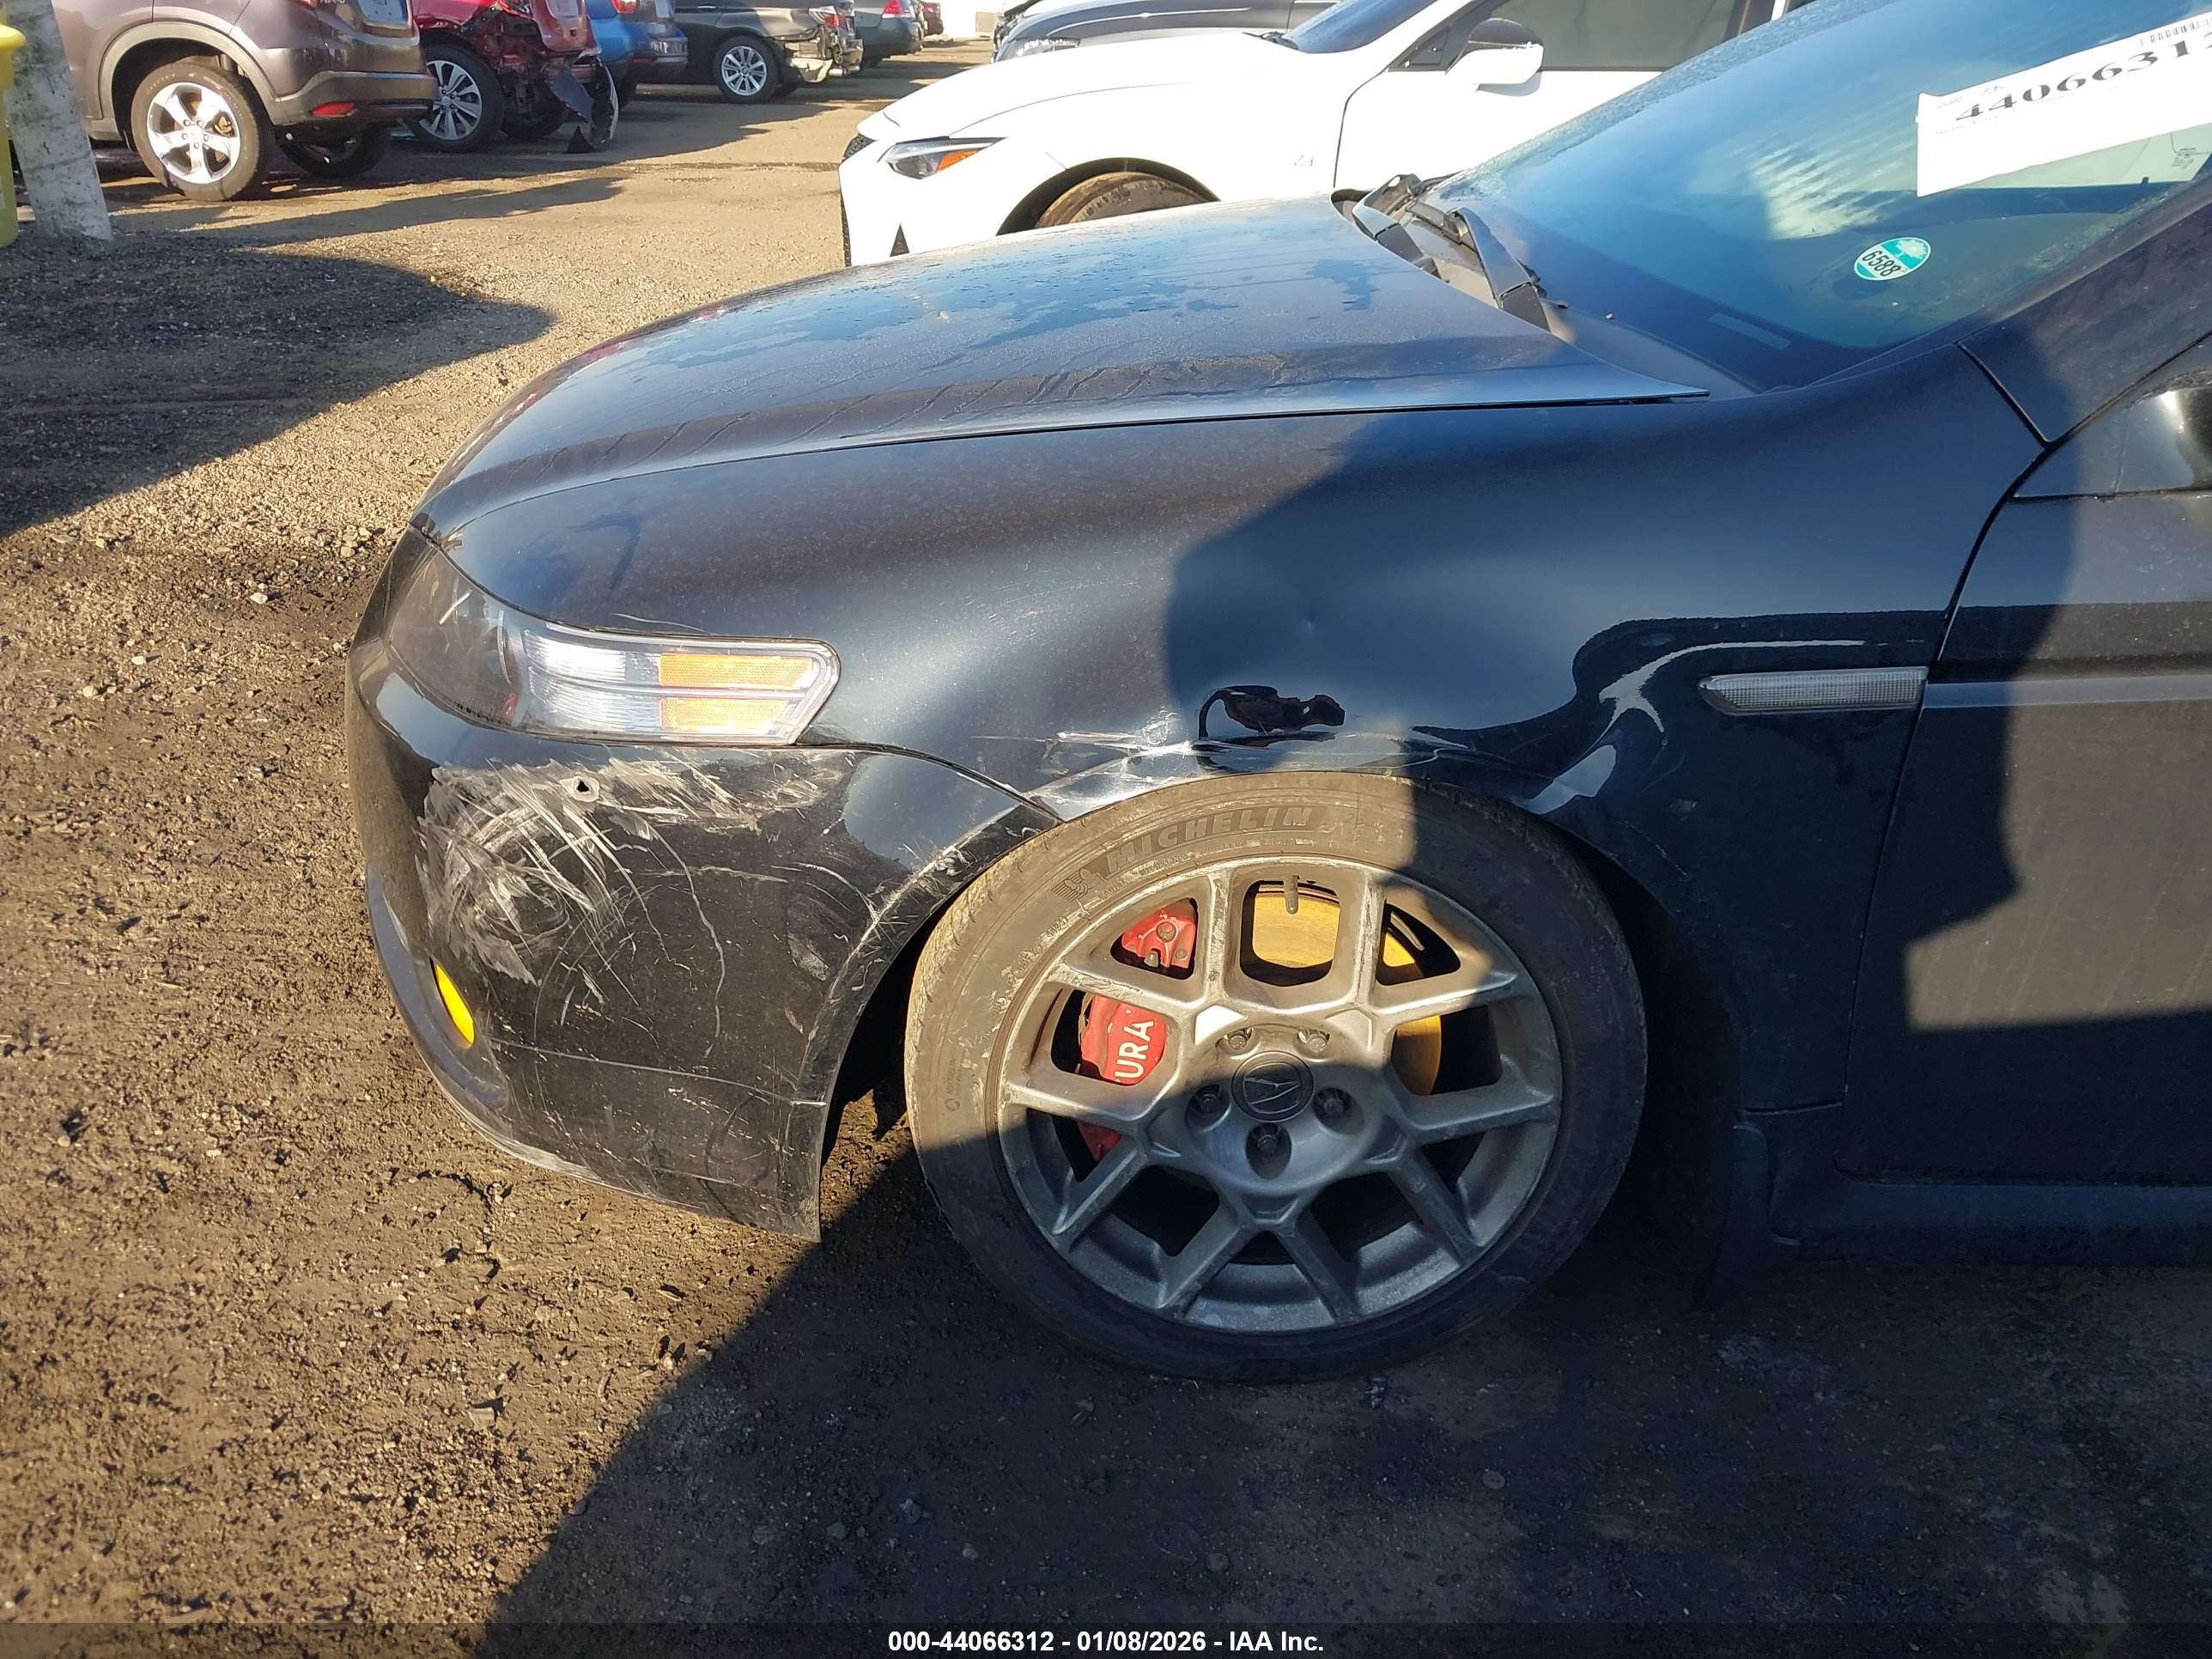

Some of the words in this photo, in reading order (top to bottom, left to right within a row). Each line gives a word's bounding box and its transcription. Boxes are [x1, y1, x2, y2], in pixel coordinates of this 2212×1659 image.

[1862, 250, 1902, 276] 6588
[1107, 807, 1313, 872] MICHELIN
[1114, 1020, 1154, 1082] URA
